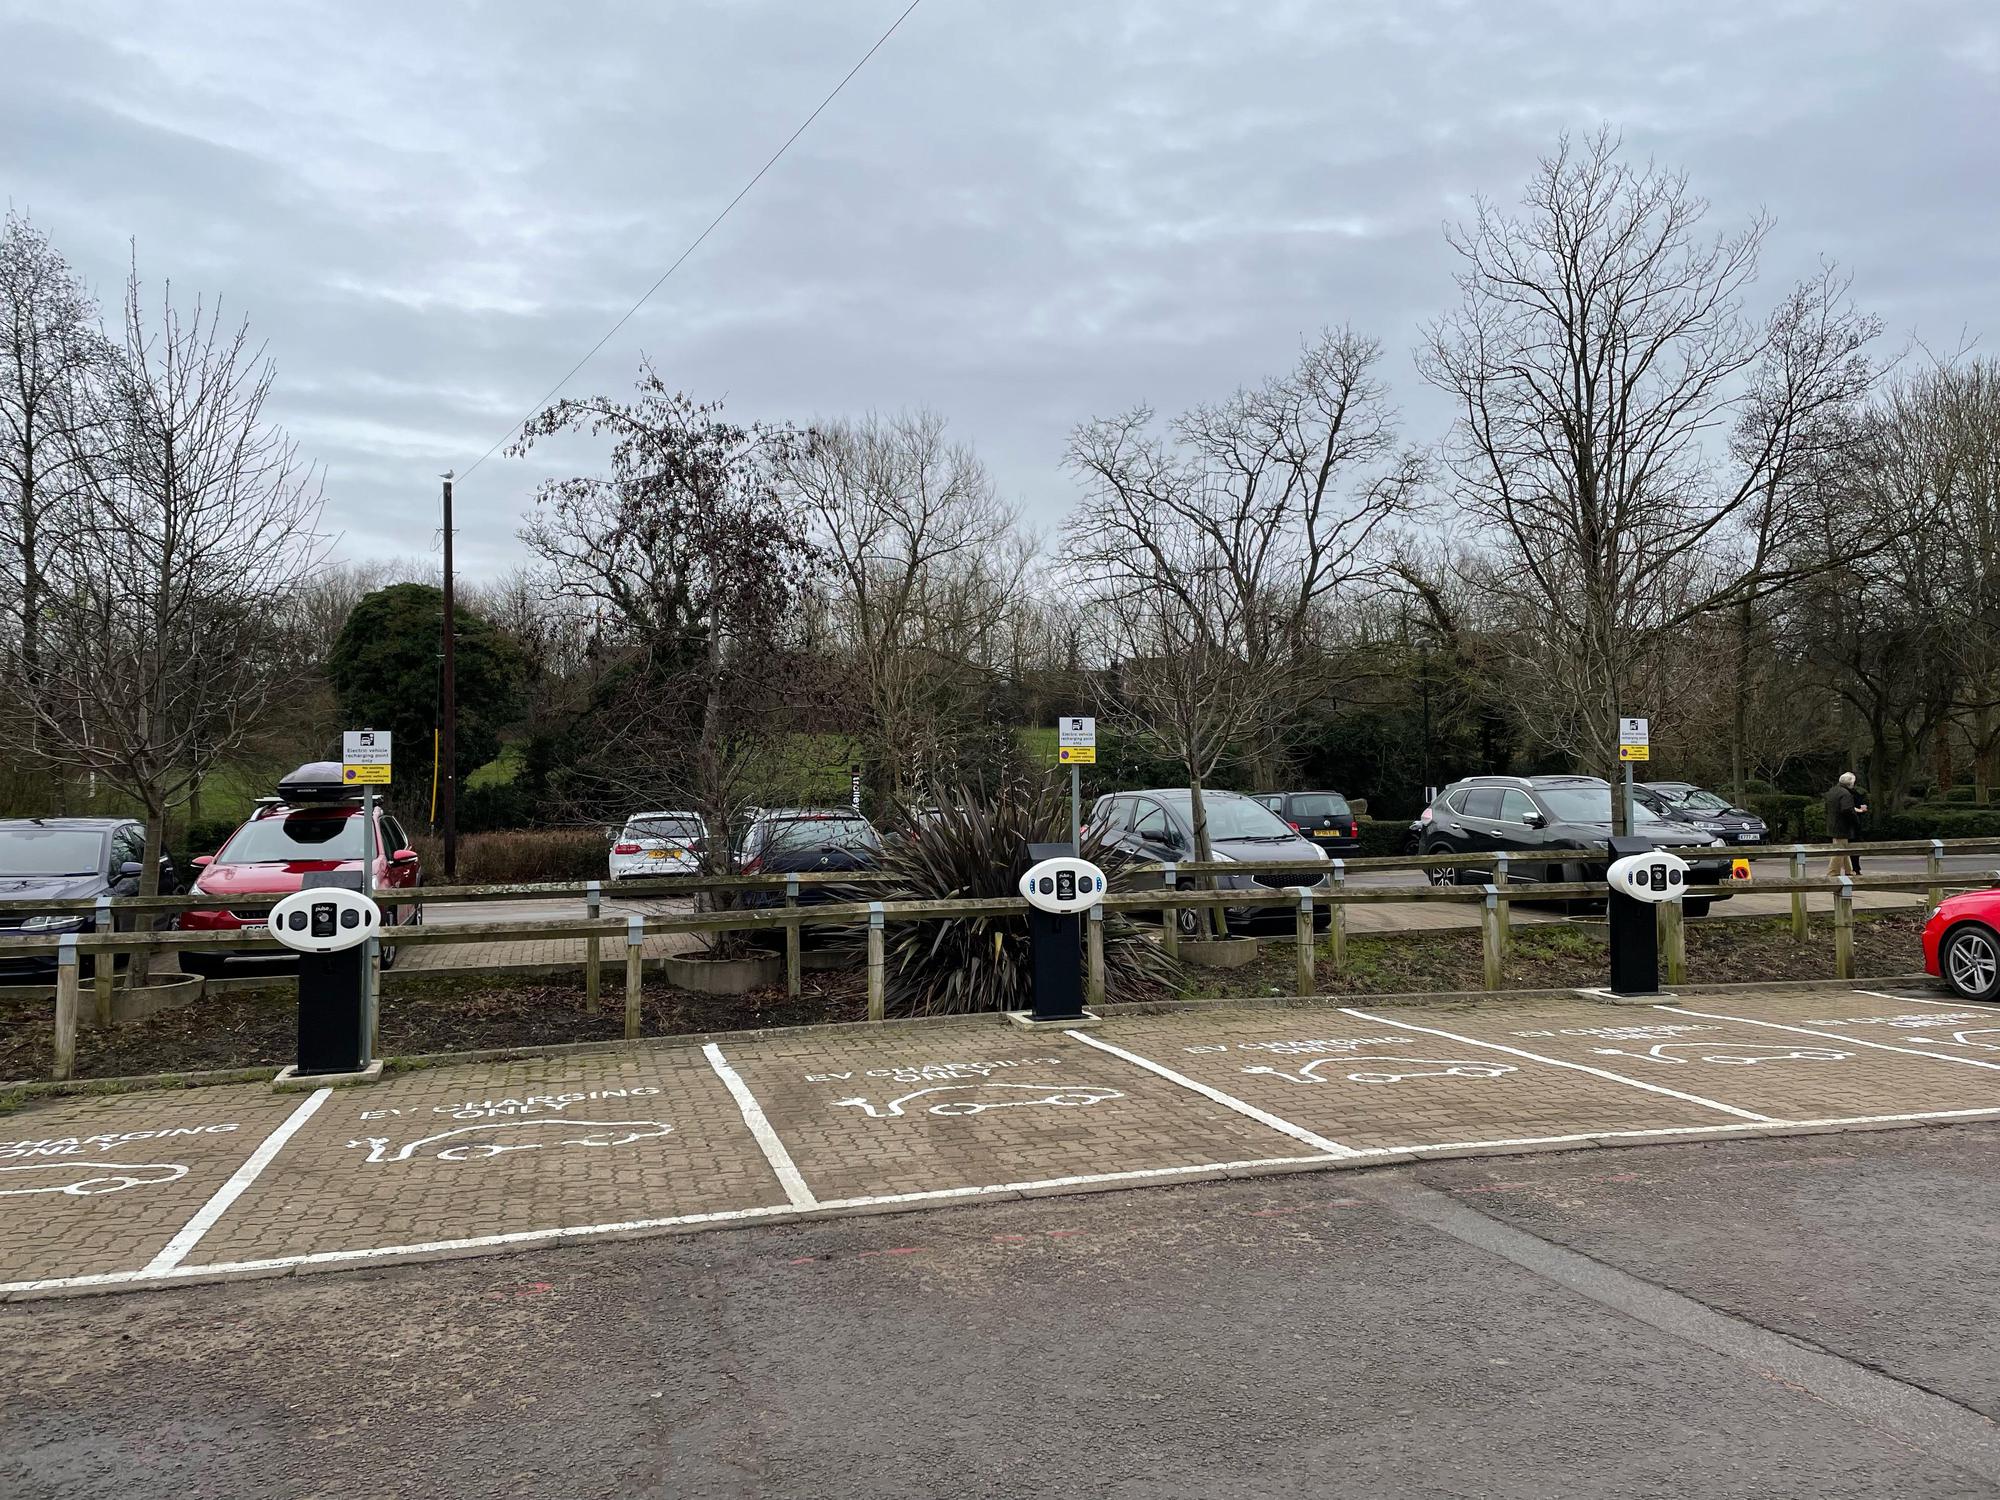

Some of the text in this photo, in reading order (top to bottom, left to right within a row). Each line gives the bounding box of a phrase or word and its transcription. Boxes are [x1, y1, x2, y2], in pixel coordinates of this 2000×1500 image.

[852, 776, 860, 811] trolley
[1183, 1037, 1414, 1054] EV CHARGING
[804, 1071, 853, 1082] EV
[893, 1069, 992, 1082] ONLY
[359, 1087, 661, 1120] EV CHARGING
[452, 1101, 572, 1119] ONLY
